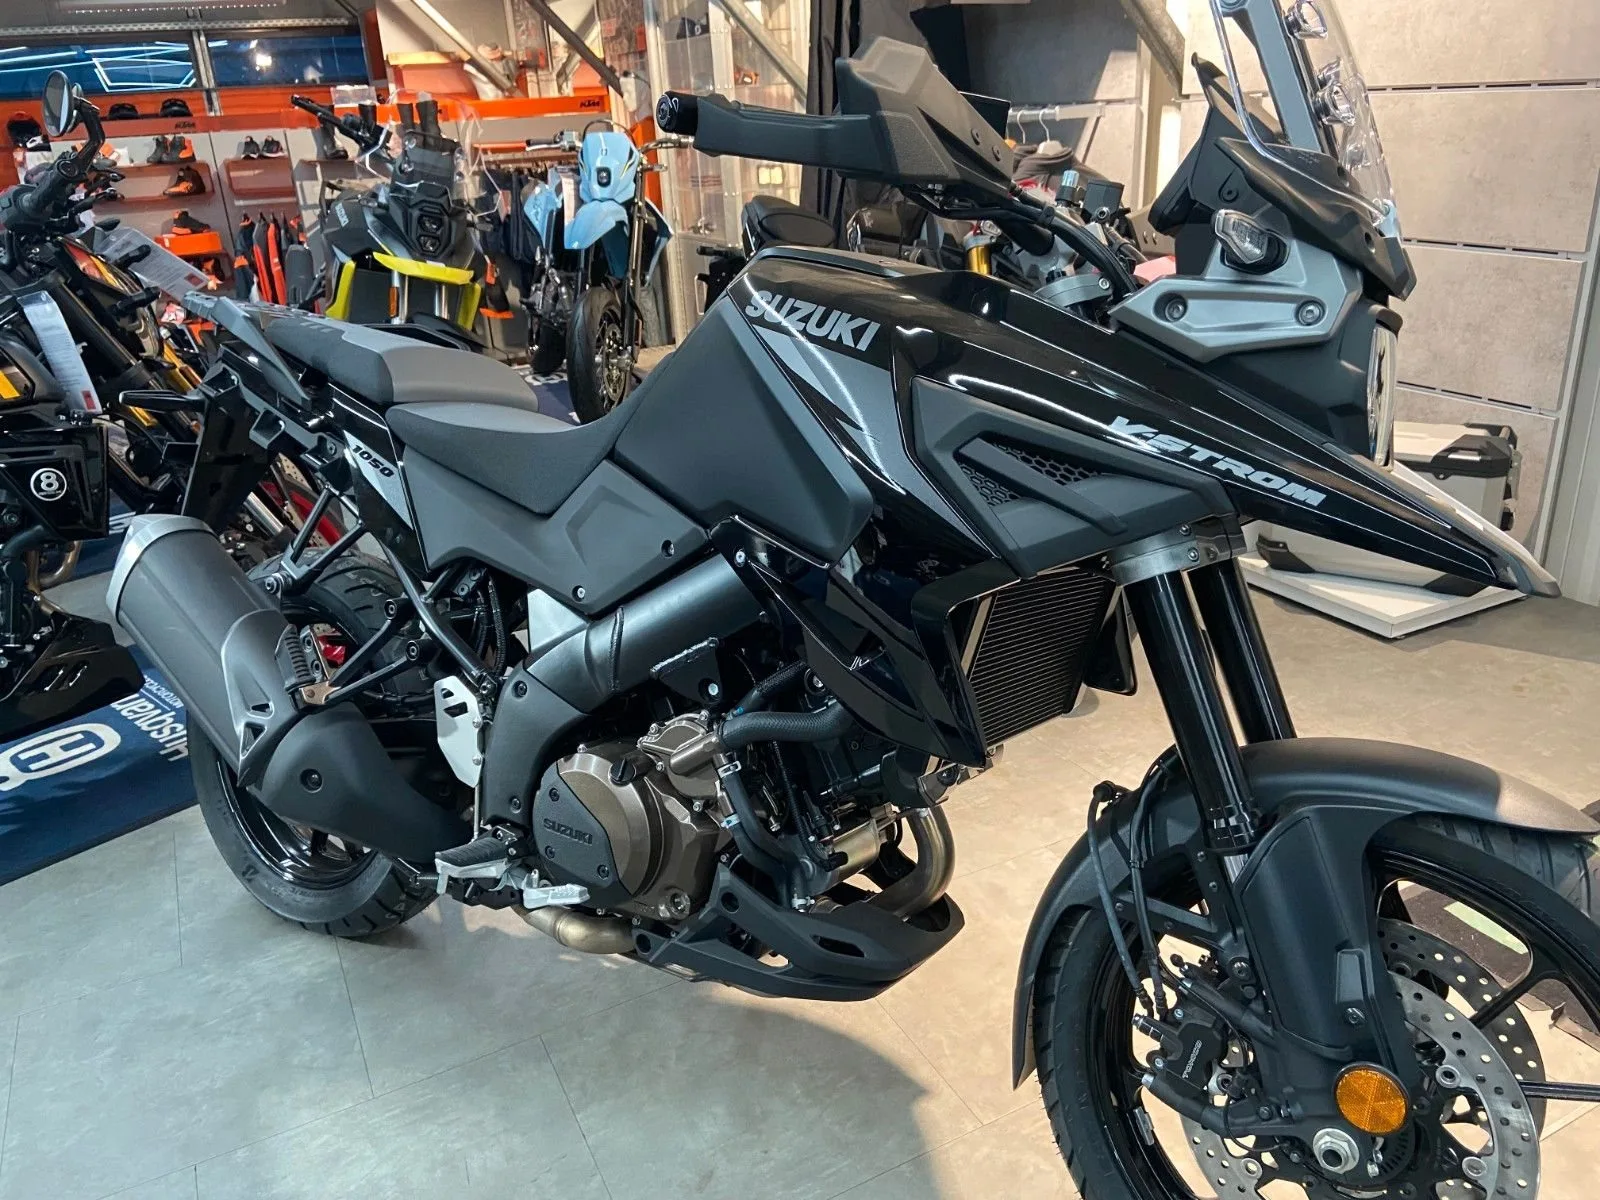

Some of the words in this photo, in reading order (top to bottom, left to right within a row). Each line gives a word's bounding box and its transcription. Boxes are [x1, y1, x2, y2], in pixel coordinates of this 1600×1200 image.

[745, 290, 881, 352] SUZUKI
[352, 444, 395, 478] 1050
[1110, 415, 1327, 507] V-STROM
[40, 471, 59, 491] 8
[543, 818, 593, 846] SUZUKI
